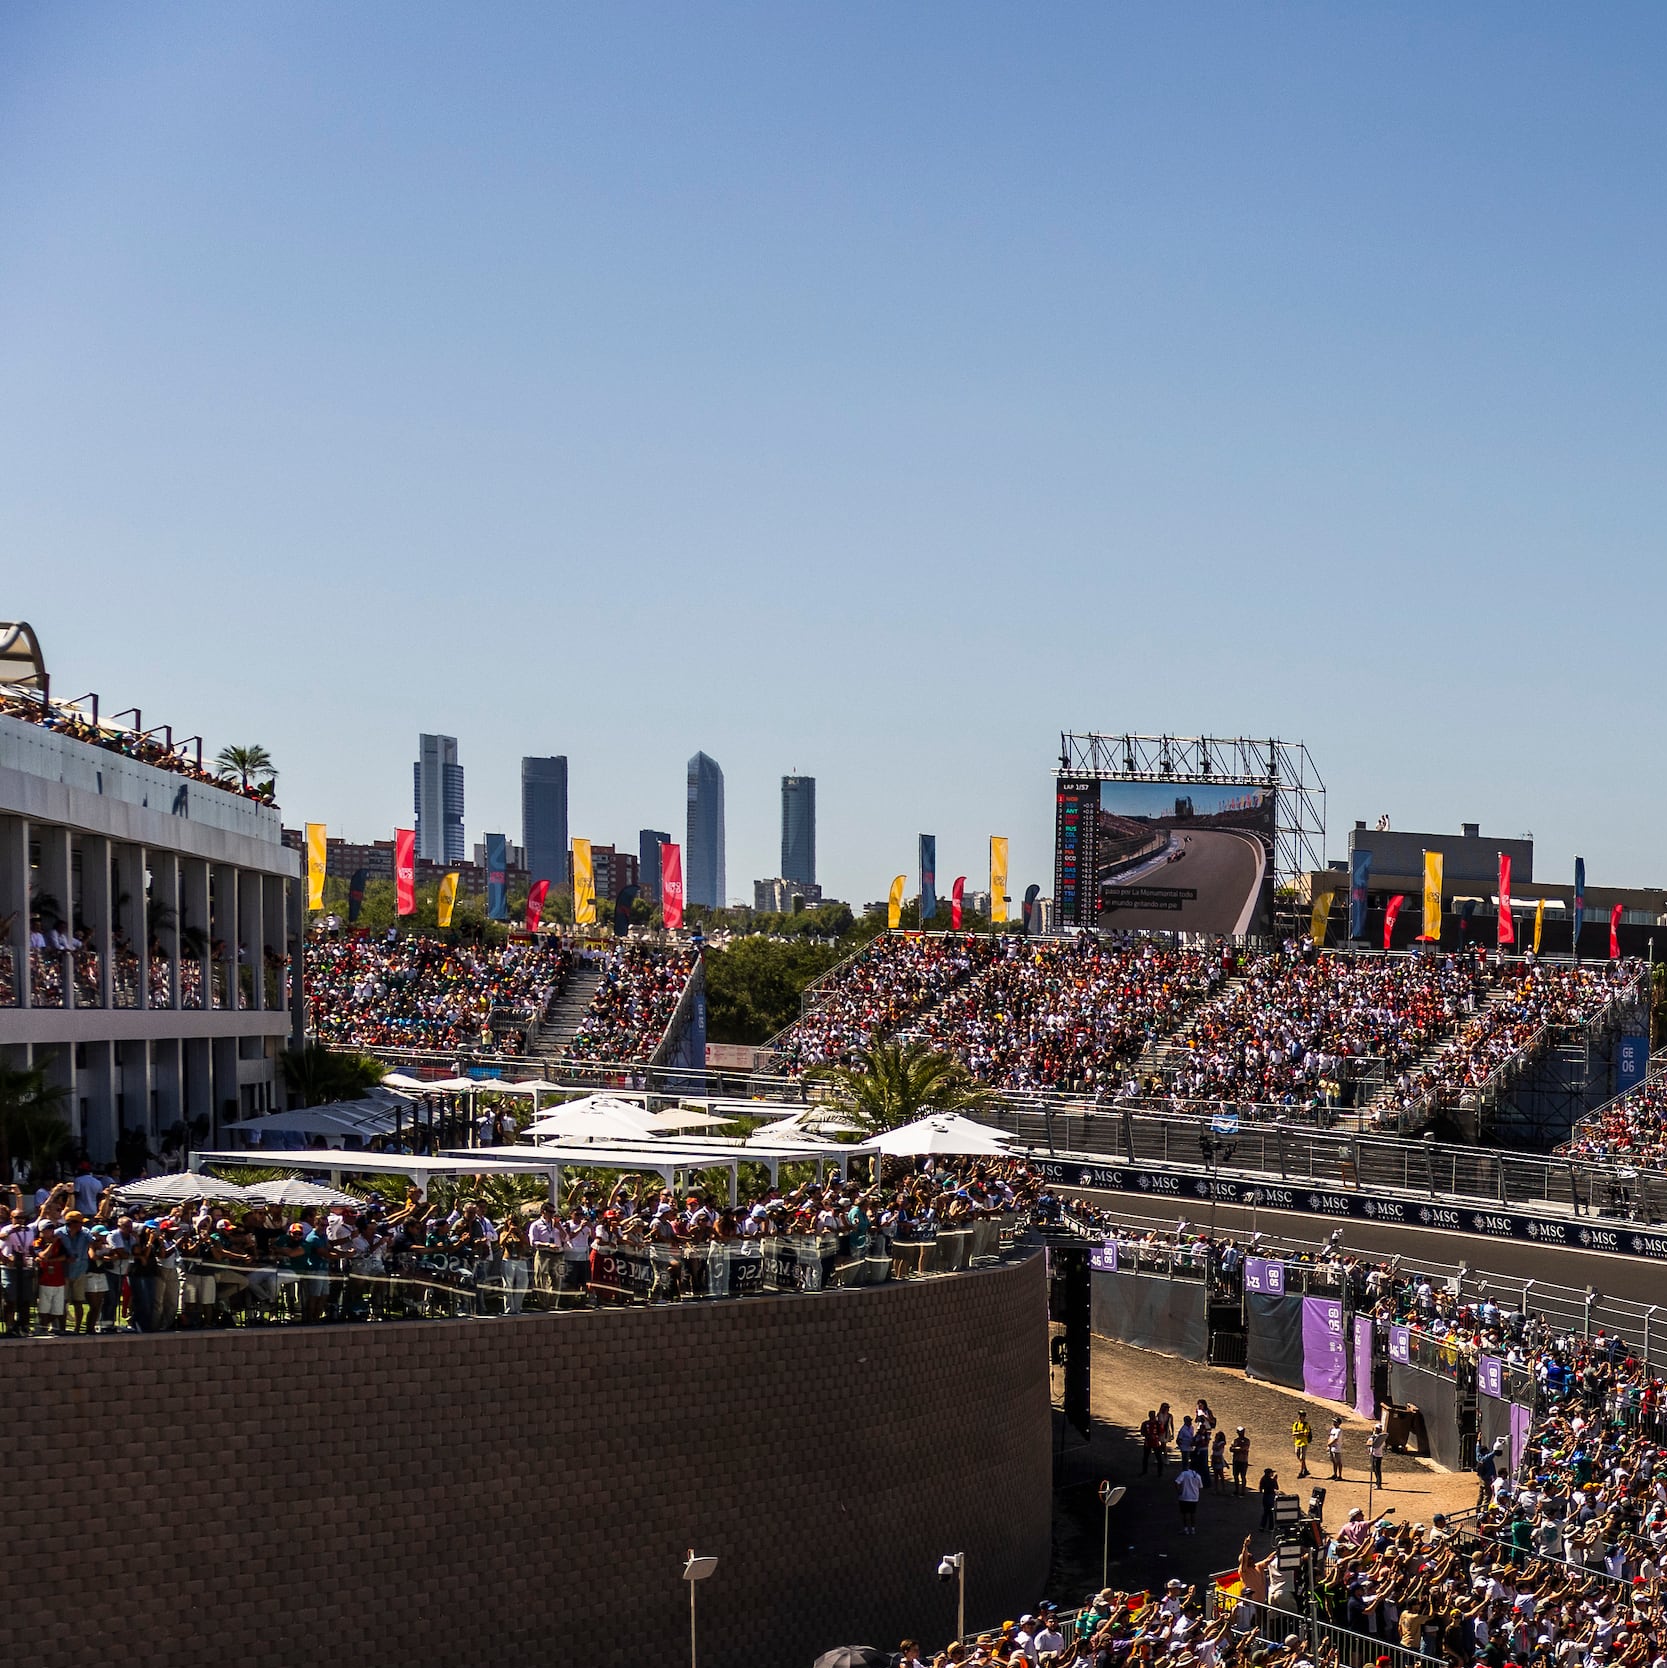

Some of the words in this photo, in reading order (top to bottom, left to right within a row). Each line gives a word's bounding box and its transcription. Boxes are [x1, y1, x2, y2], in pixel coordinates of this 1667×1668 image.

[1623, 1047, 1634, 1058] GE
[1622, 1060, 1635, 1073] 06
[1095, 1170, 1121, 1183] MSC
[1152, 1176, 1178, 1189] MSC
[1210, 1184, 1236, 1196] MSC
[1266, 1189, 1292, 1202] MSC
[1323, 1196, 1348, 1209] MSC
[1377, 1202, 1403, 1216] MSC
[1433, 1209, 1458, 1223] MSC
[1486, 1216, 1511, 1230] MSC
[1540, 1224, 1564, 1238] MSC
[1592, 1231, 1617, 1245] MSC
[1103, 1247, 1113, 1255] GD
[1269, 1268, 1279, 1278] GD
[1269, 1278, 1279, 1287] 05
[1328, 1307, 1339, 1319] GD
[1328, 1320, 1340, 1332] 05
